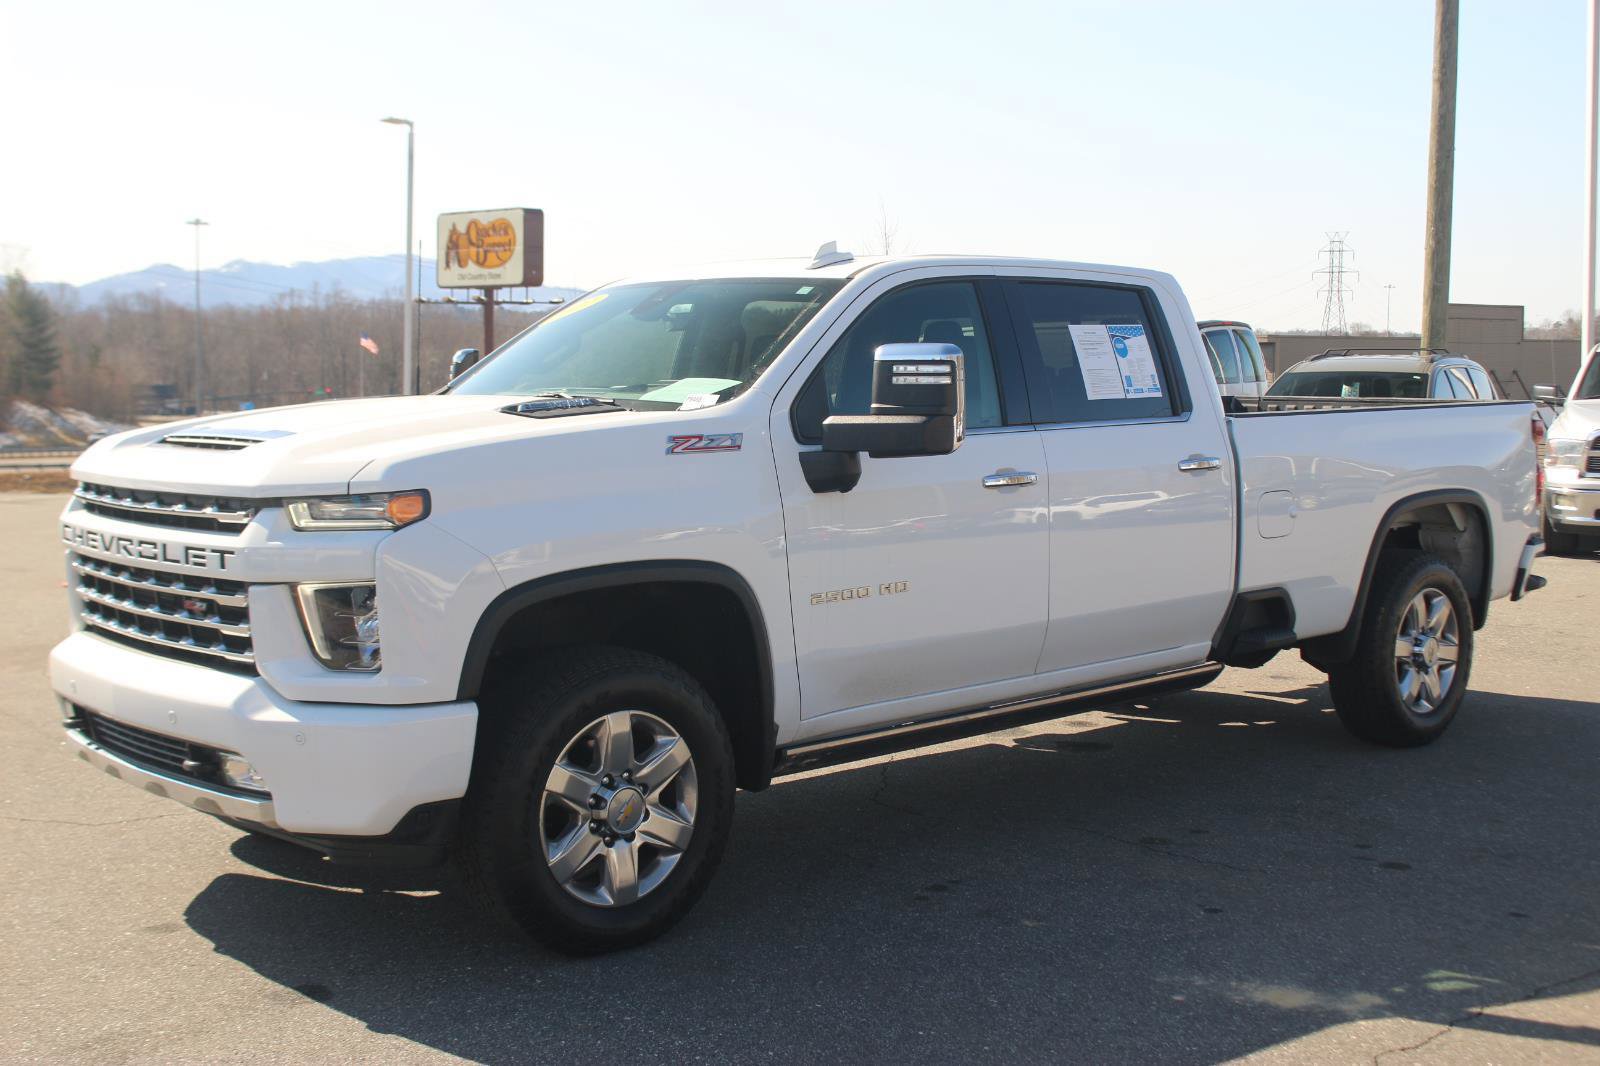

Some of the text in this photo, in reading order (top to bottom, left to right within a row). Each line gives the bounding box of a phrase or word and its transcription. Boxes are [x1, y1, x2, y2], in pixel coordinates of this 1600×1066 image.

[665, 433, 743, 455] Z71
[61, 524, 236, 570] CHEVROLET
[810, 580, 912, 606] 2500 HD
